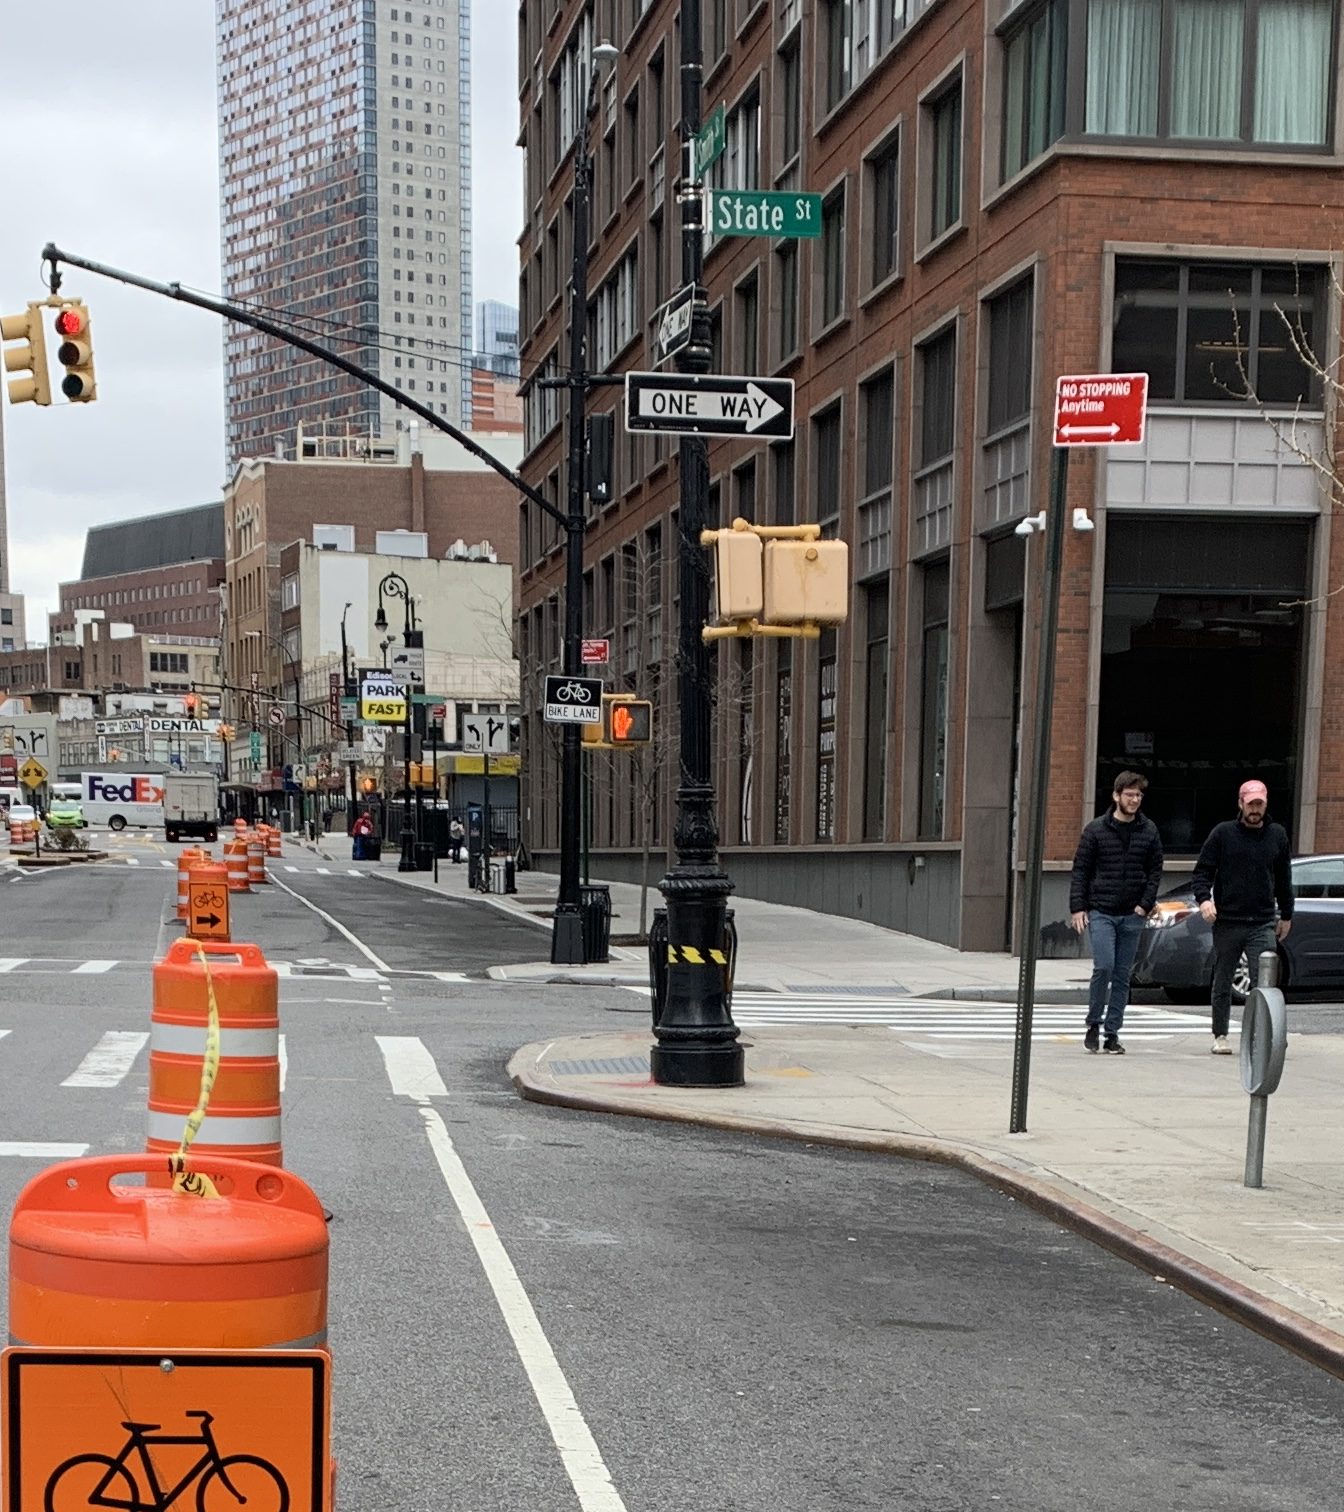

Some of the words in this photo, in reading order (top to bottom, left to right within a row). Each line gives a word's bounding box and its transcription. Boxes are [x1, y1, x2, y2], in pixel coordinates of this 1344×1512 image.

[718, 195, 784, 231] State
[795, 198, 812, 220] St
[1062, 383, 1077, 397] NO
[1079, 381, 1131, 397] STOPPING
[652, 392, 698, 415] ONE
[720, 395, 767, 418] WAY
[1061, 398, 1105, 415] Anytime
[366, 671, 393, 680] Ediso
[366, 685, 405, 697] PARK
[367, 703, 405, 715] FAST
[548, 705, 569, 717] BIKE
[573, 707, 598, 719] LANE
[151, 720, 208, 731] DENTAL
[89, 775, 166, 803] FedEx
